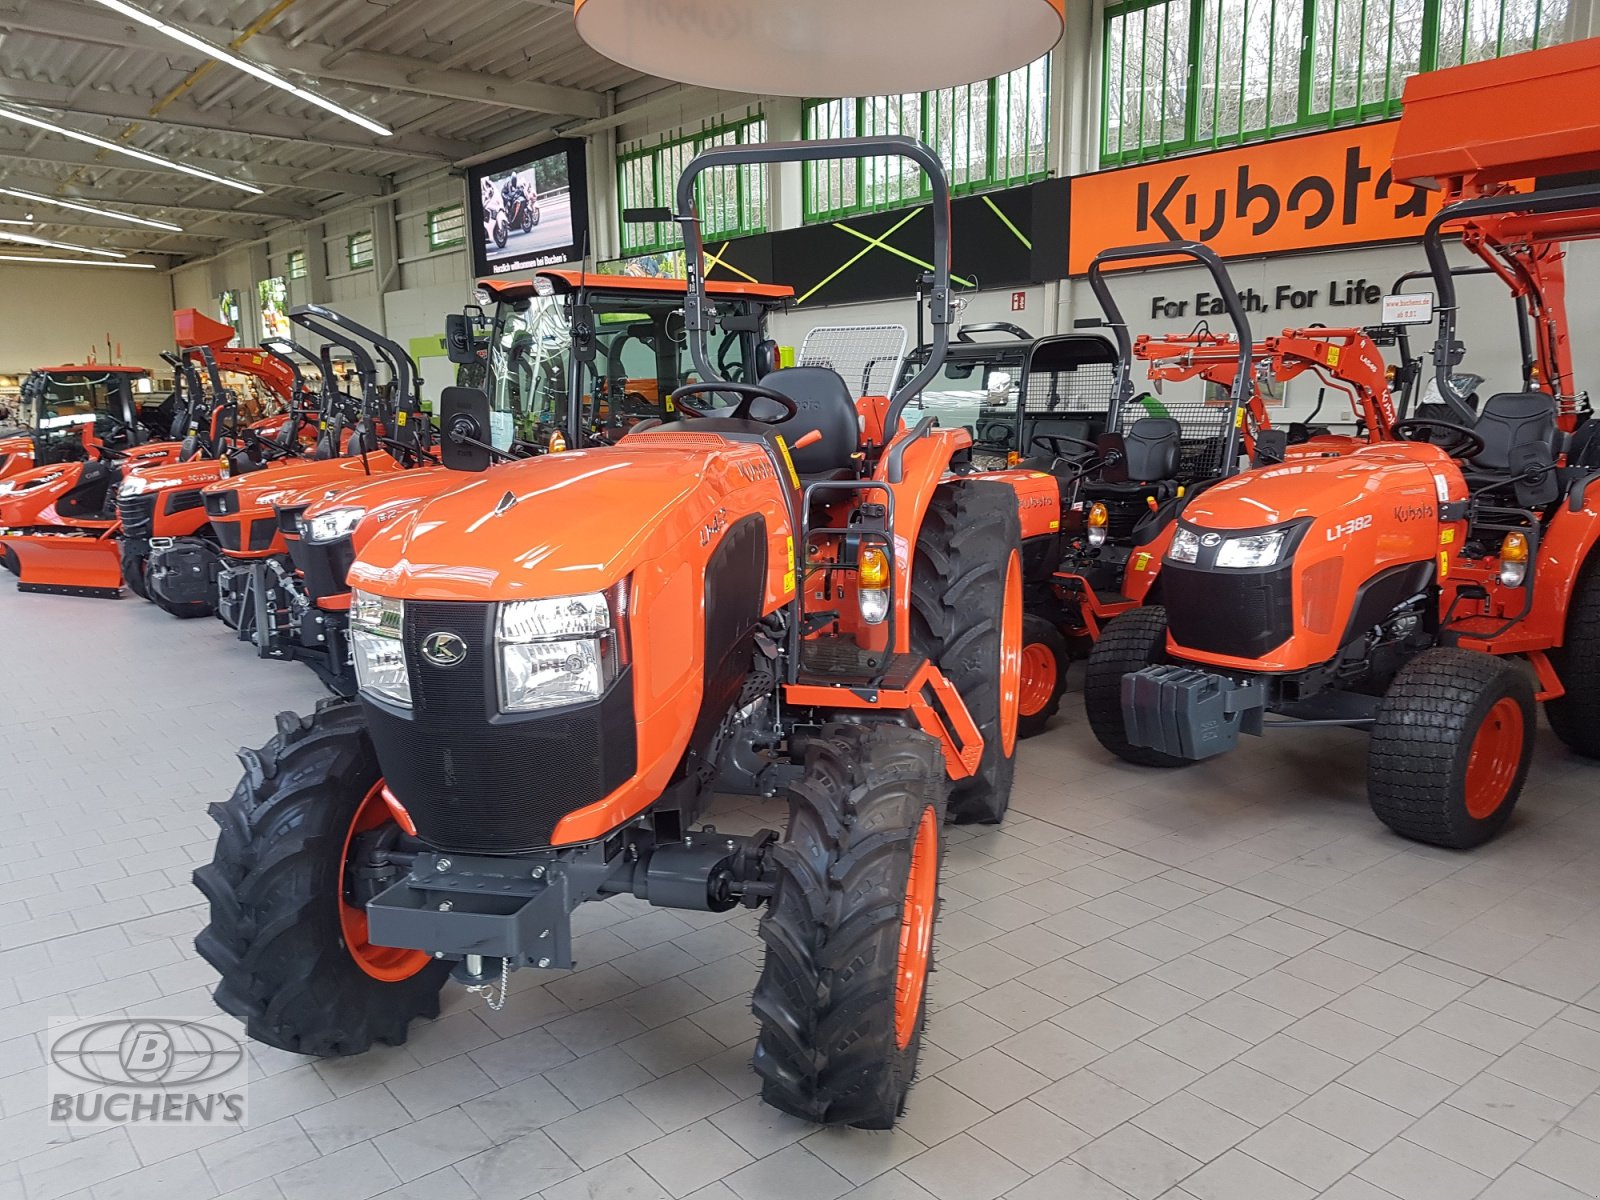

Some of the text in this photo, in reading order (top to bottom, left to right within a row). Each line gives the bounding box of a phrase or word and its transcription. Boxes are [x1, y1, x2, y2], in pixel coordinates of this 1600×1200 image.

[1136, 146, 1427, 242] Kubota
[493, 263, 511, 274] Herzlich
[511, 260, 537, 271] willkommen
[536, 257, 544, 267] bei
[1152, 278, 1381, 319] For Eath, For Life
[1394, 501, 1434, 523] Kubota
[1326, 514, 1373, 542] L1-382
